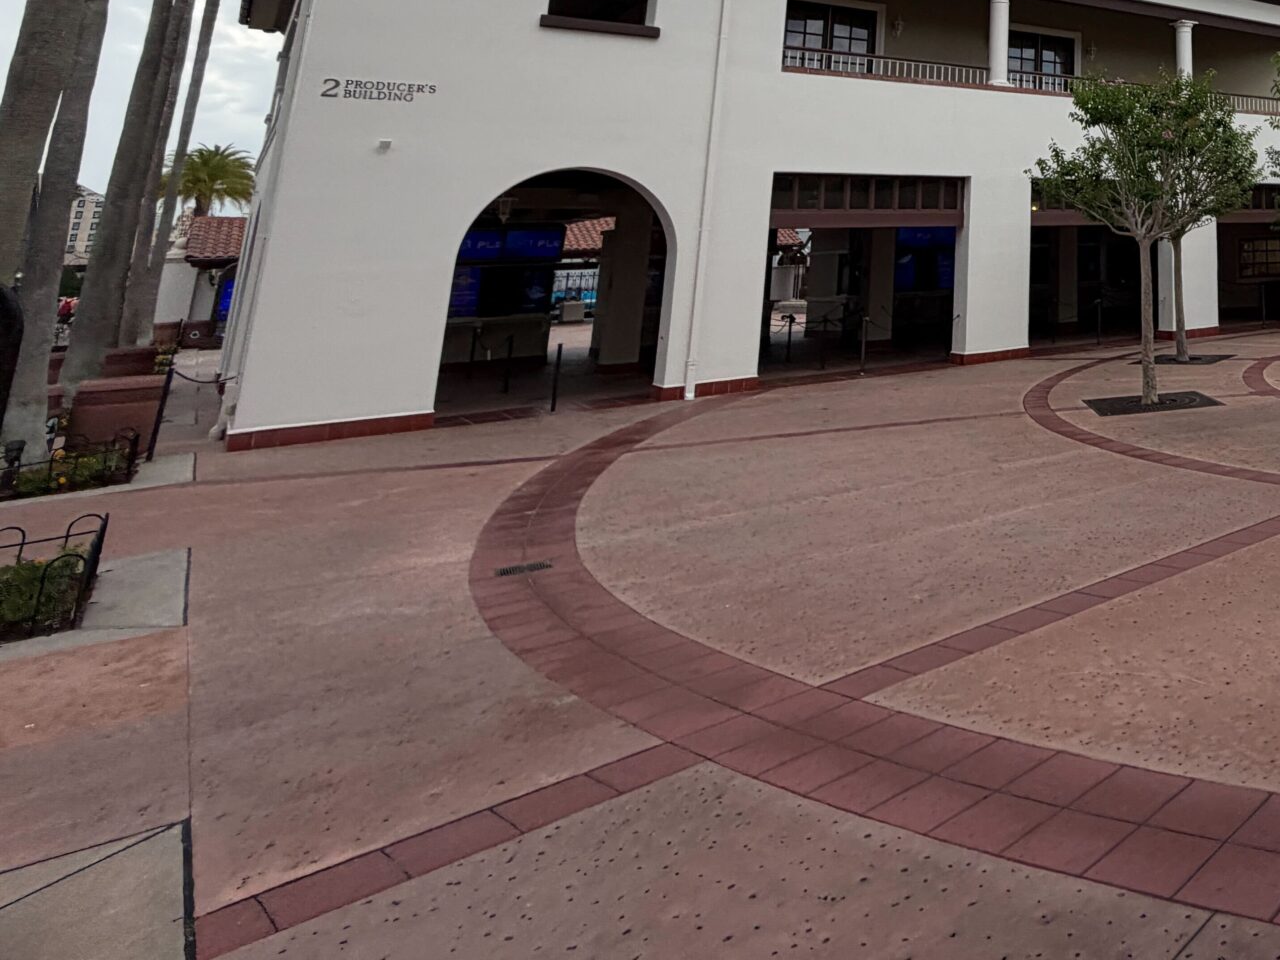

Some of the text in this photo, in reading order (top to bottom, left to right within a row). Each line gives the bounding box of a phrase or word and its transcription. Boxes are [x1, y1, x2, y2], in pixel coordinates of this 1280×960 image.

[320, 78, 437, 98] 2 PRODUCER'S
[343, 89, 414, 103] BUILDING
